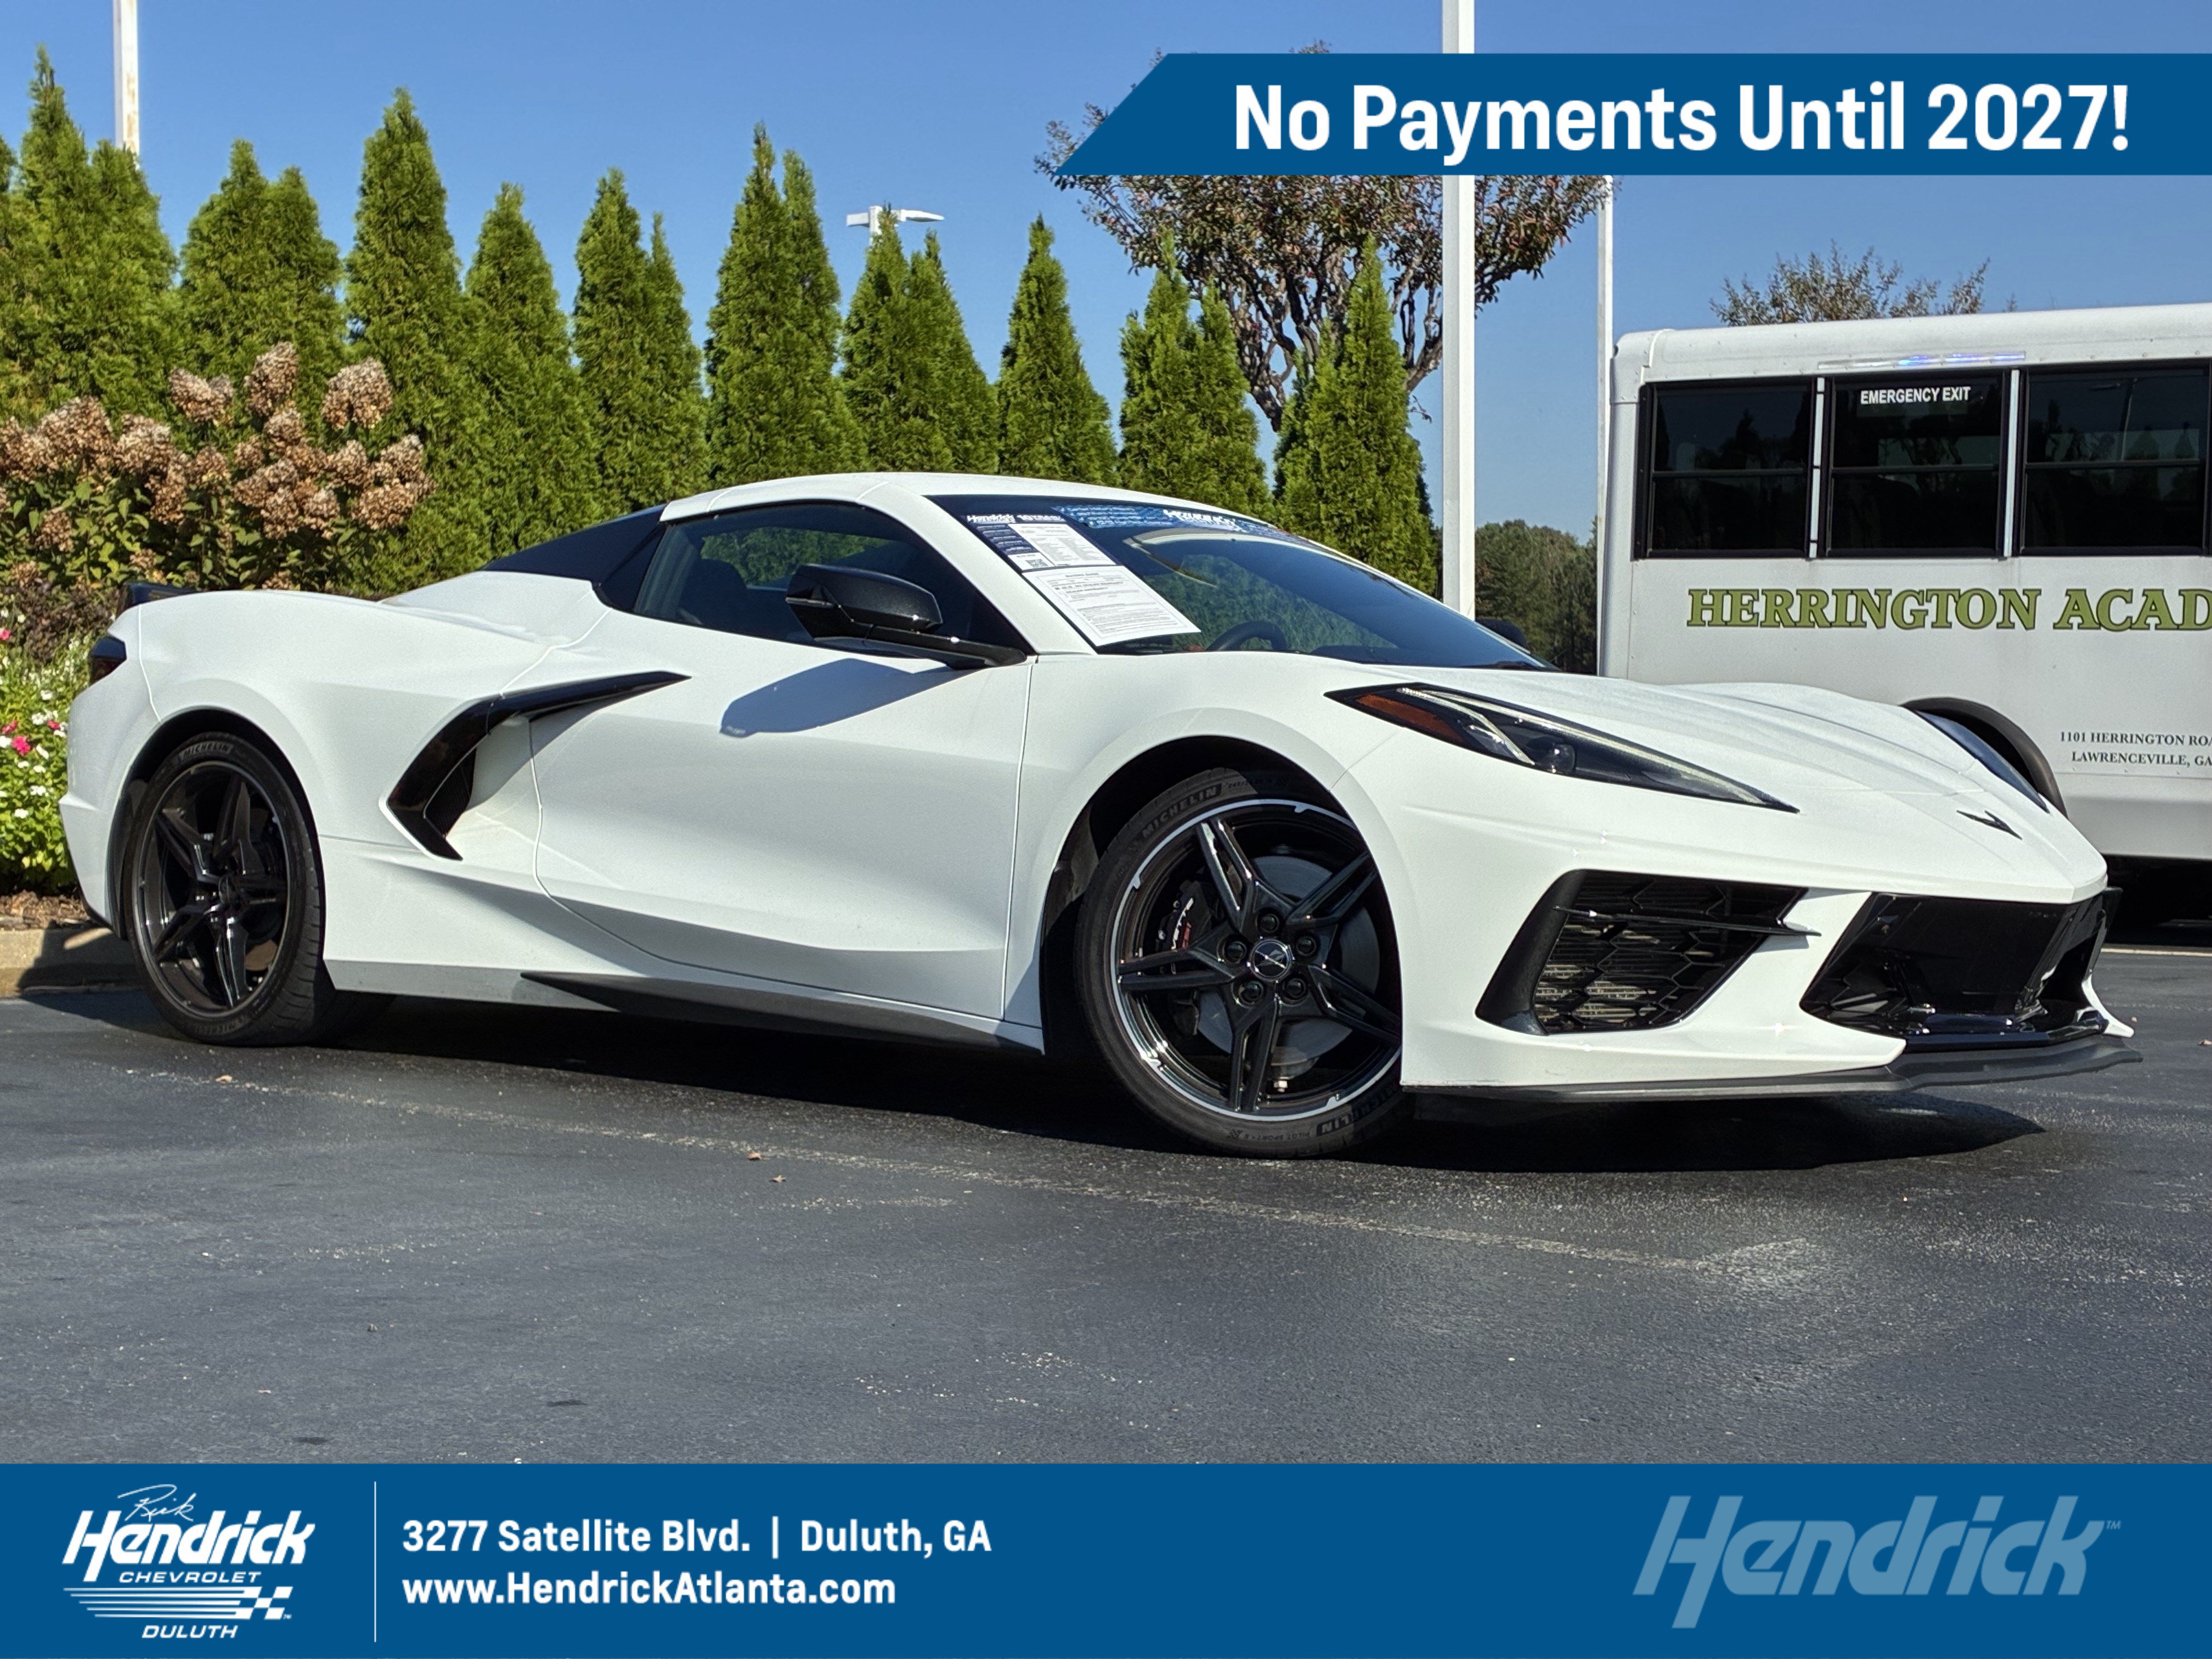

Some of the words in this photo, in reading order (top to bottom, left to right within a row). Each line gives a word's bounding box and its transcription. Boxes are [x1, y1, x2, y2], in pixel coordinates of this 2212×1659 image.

[1860, 387, 1940, 404] EMERGENCY
[1942, 386, 1971, 402] EXIT
[1687, 588, 2041, 630] HERRINGTON
[2053, 589, 2212, 631] ACAD
[2061, 731, 2086, 742] 1101
[2091, 732, 2185, 746] HERRINGTON
[2072, 751, 2190, 768] LAWRENCEVILLE,
[1141, 785, 1217, 838] MICHELIN
